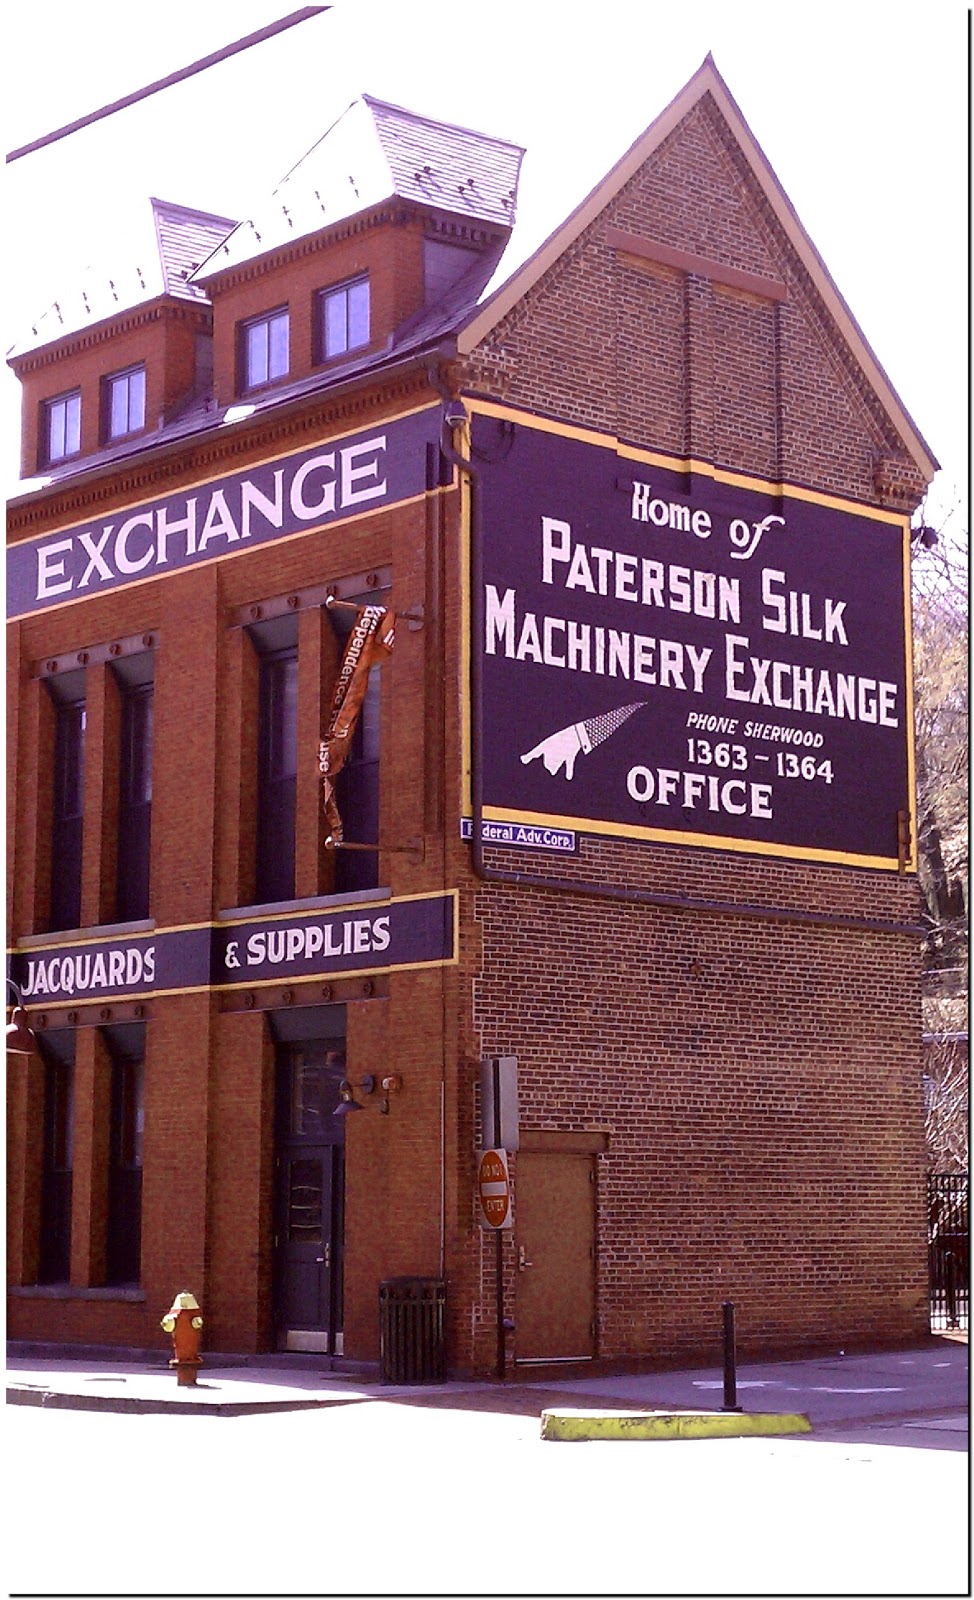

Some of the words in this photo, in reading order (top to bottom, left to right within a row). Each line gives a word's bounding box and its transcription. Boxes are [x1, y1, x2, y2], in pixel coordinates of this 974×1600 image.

[35, 435, 387, 601] EXCHANGE
[631, 481, 712, 539] Home
[729, 514, 786, 560] of
[541, 515, 741, 625] PATERSON
[761, 567, 850, 646] SILK
[484, 584, 713, 694] MACHINERY
[725, 632, 900, 729] EXCHANGE
[685, 711, 740, 738] PHONE
[743, 720, 825, 749] SHERWOOD
[687, 738, 748, 772] 1363
[776, 751, 835, 784] 1364
[467, 822, 513, 840] Fderal
[626, 765, 774, 819] OFFICE
[20, 946, 155, 996] JACQUARDS
[224, 941, 241, 969] &
[246, 915, 392, 966] SUPPLIES
